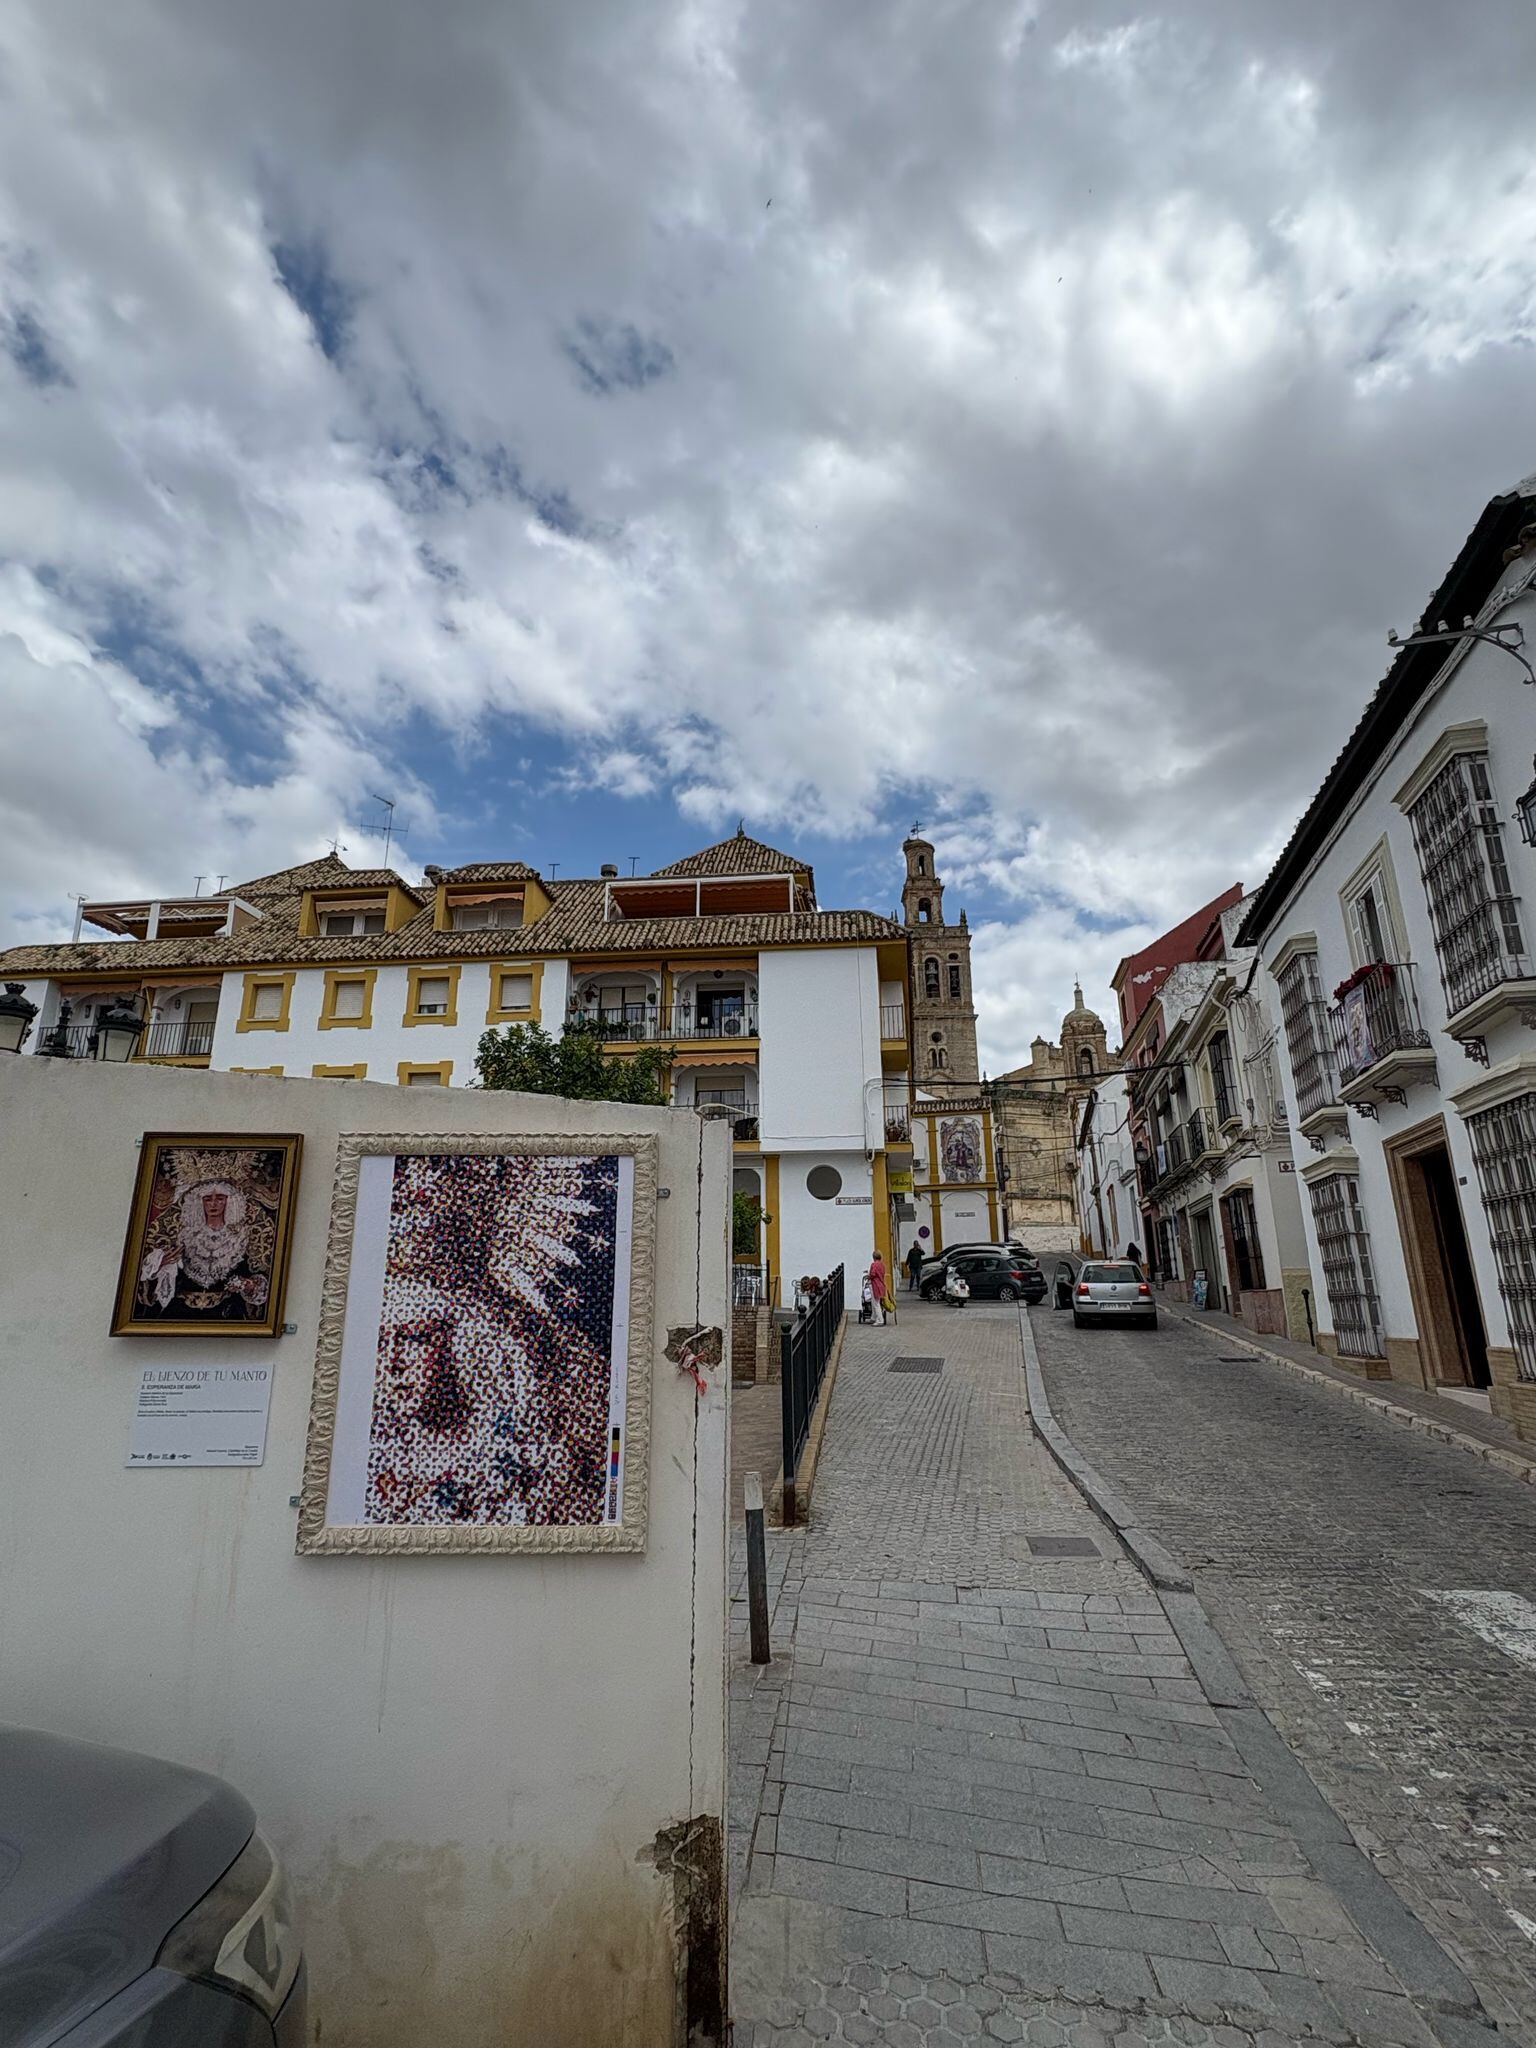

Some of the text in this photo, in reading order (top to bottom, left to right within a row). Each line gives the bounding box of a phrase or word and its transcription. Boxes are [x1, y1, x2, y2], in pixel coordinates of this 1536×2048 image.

[143, 1370, 267, 1382] EL LIENZO DE TU MANTO
